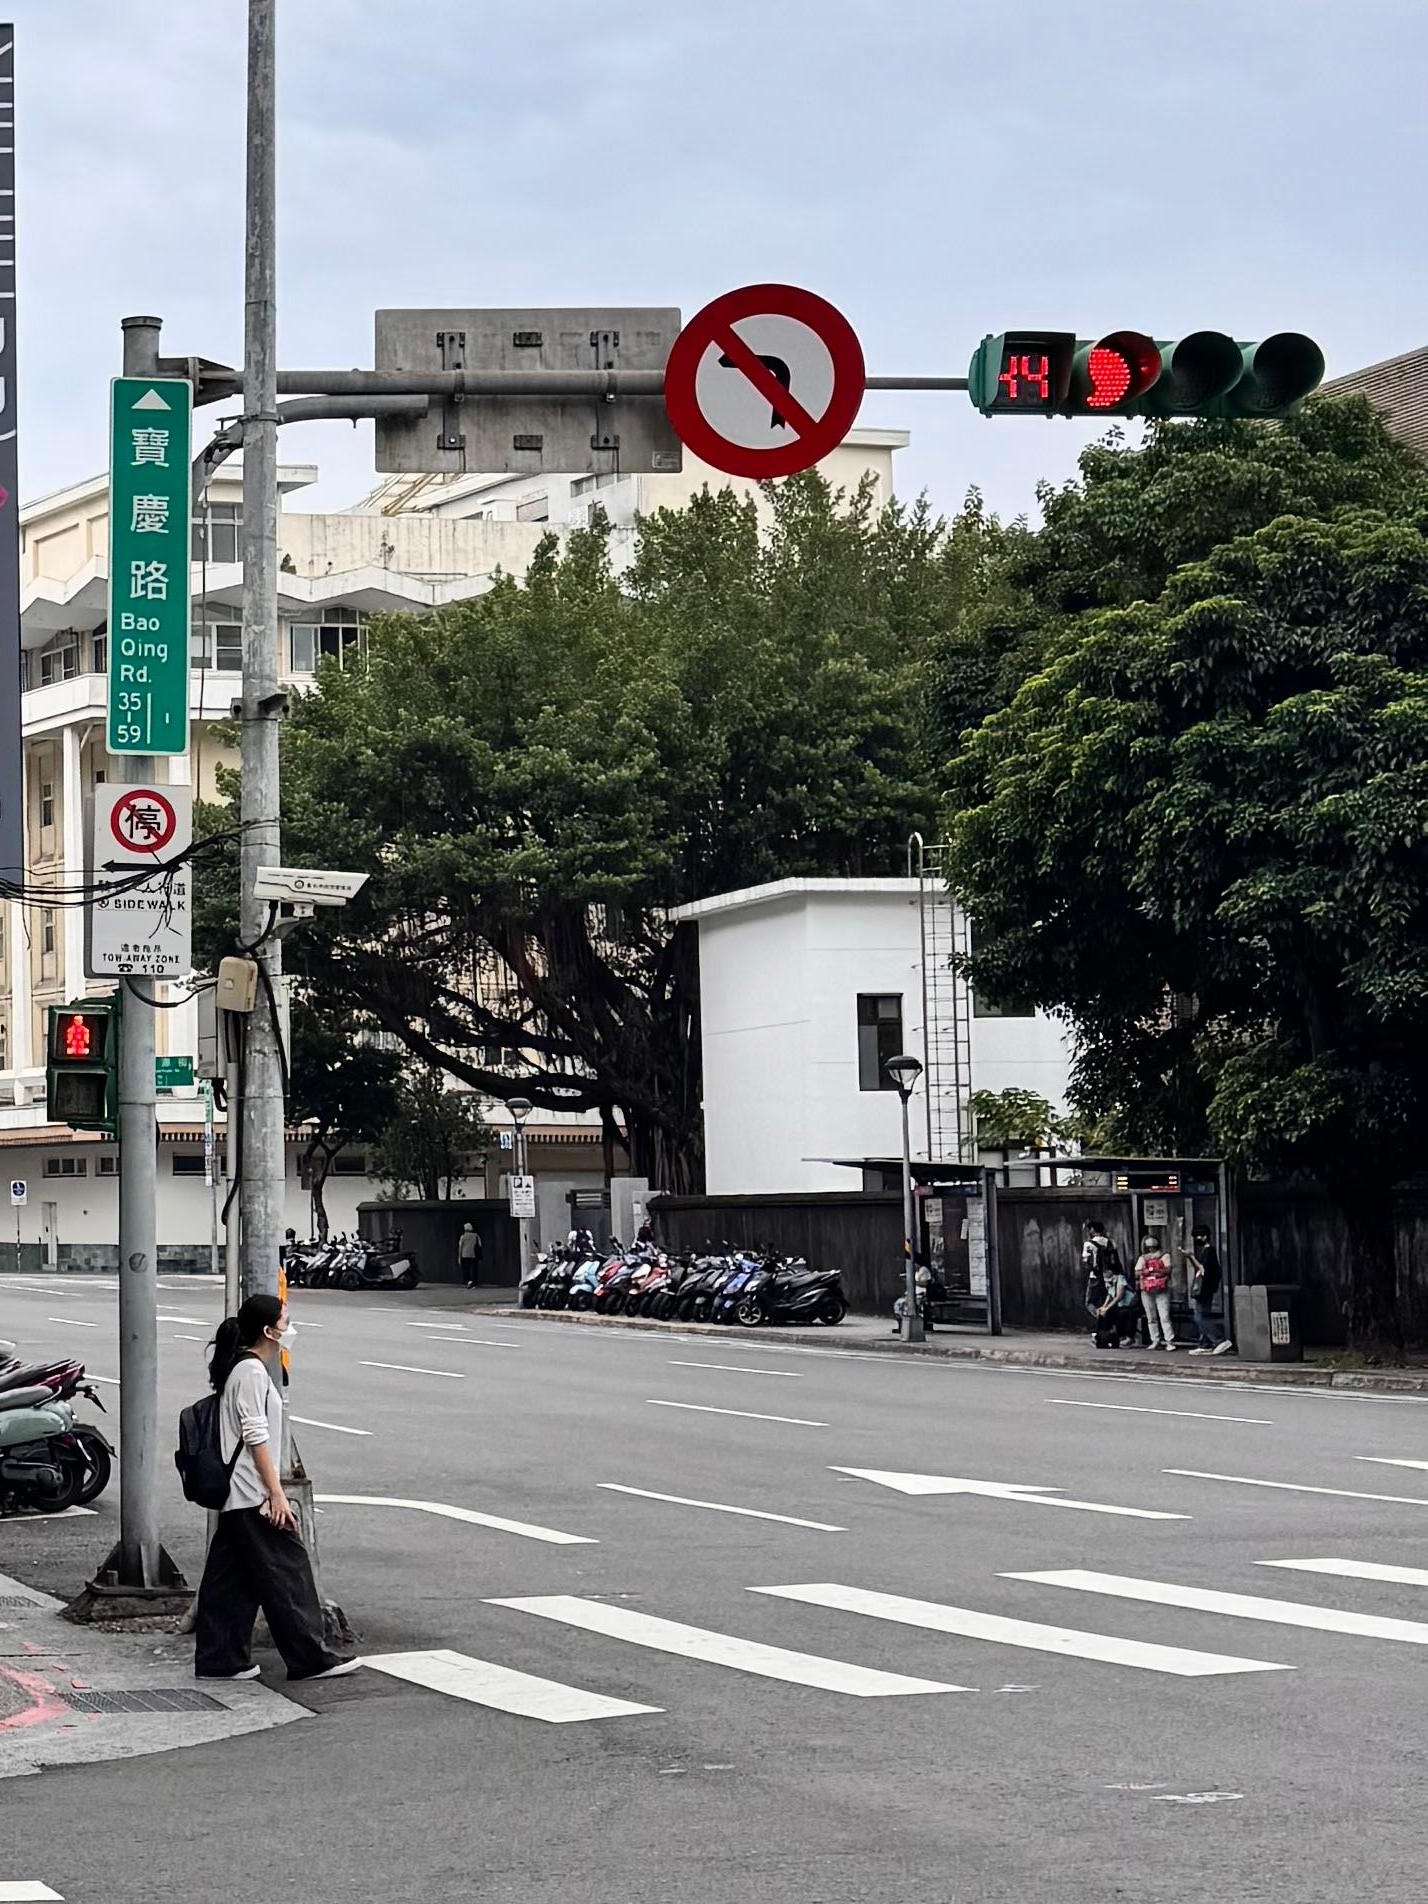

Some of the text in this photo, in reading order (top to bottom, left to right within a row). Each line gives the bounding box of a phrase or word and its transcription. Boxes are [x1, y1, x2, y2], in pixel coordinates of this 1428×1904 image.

[129, 426, 171, 601] 寶慶路
[120, 612, 160, 632] Bao
[120, 638, 168, 663] Qing
[120, 664, 152, 683] Rd.
[118, 692, 142, 711] 35
[117, 725, 141, 744] 59
[124, 804, 161, 840] 停
[102, 952, 180, 964] TOW AWAY ZONE
[142, 964, 165, 974] 110
